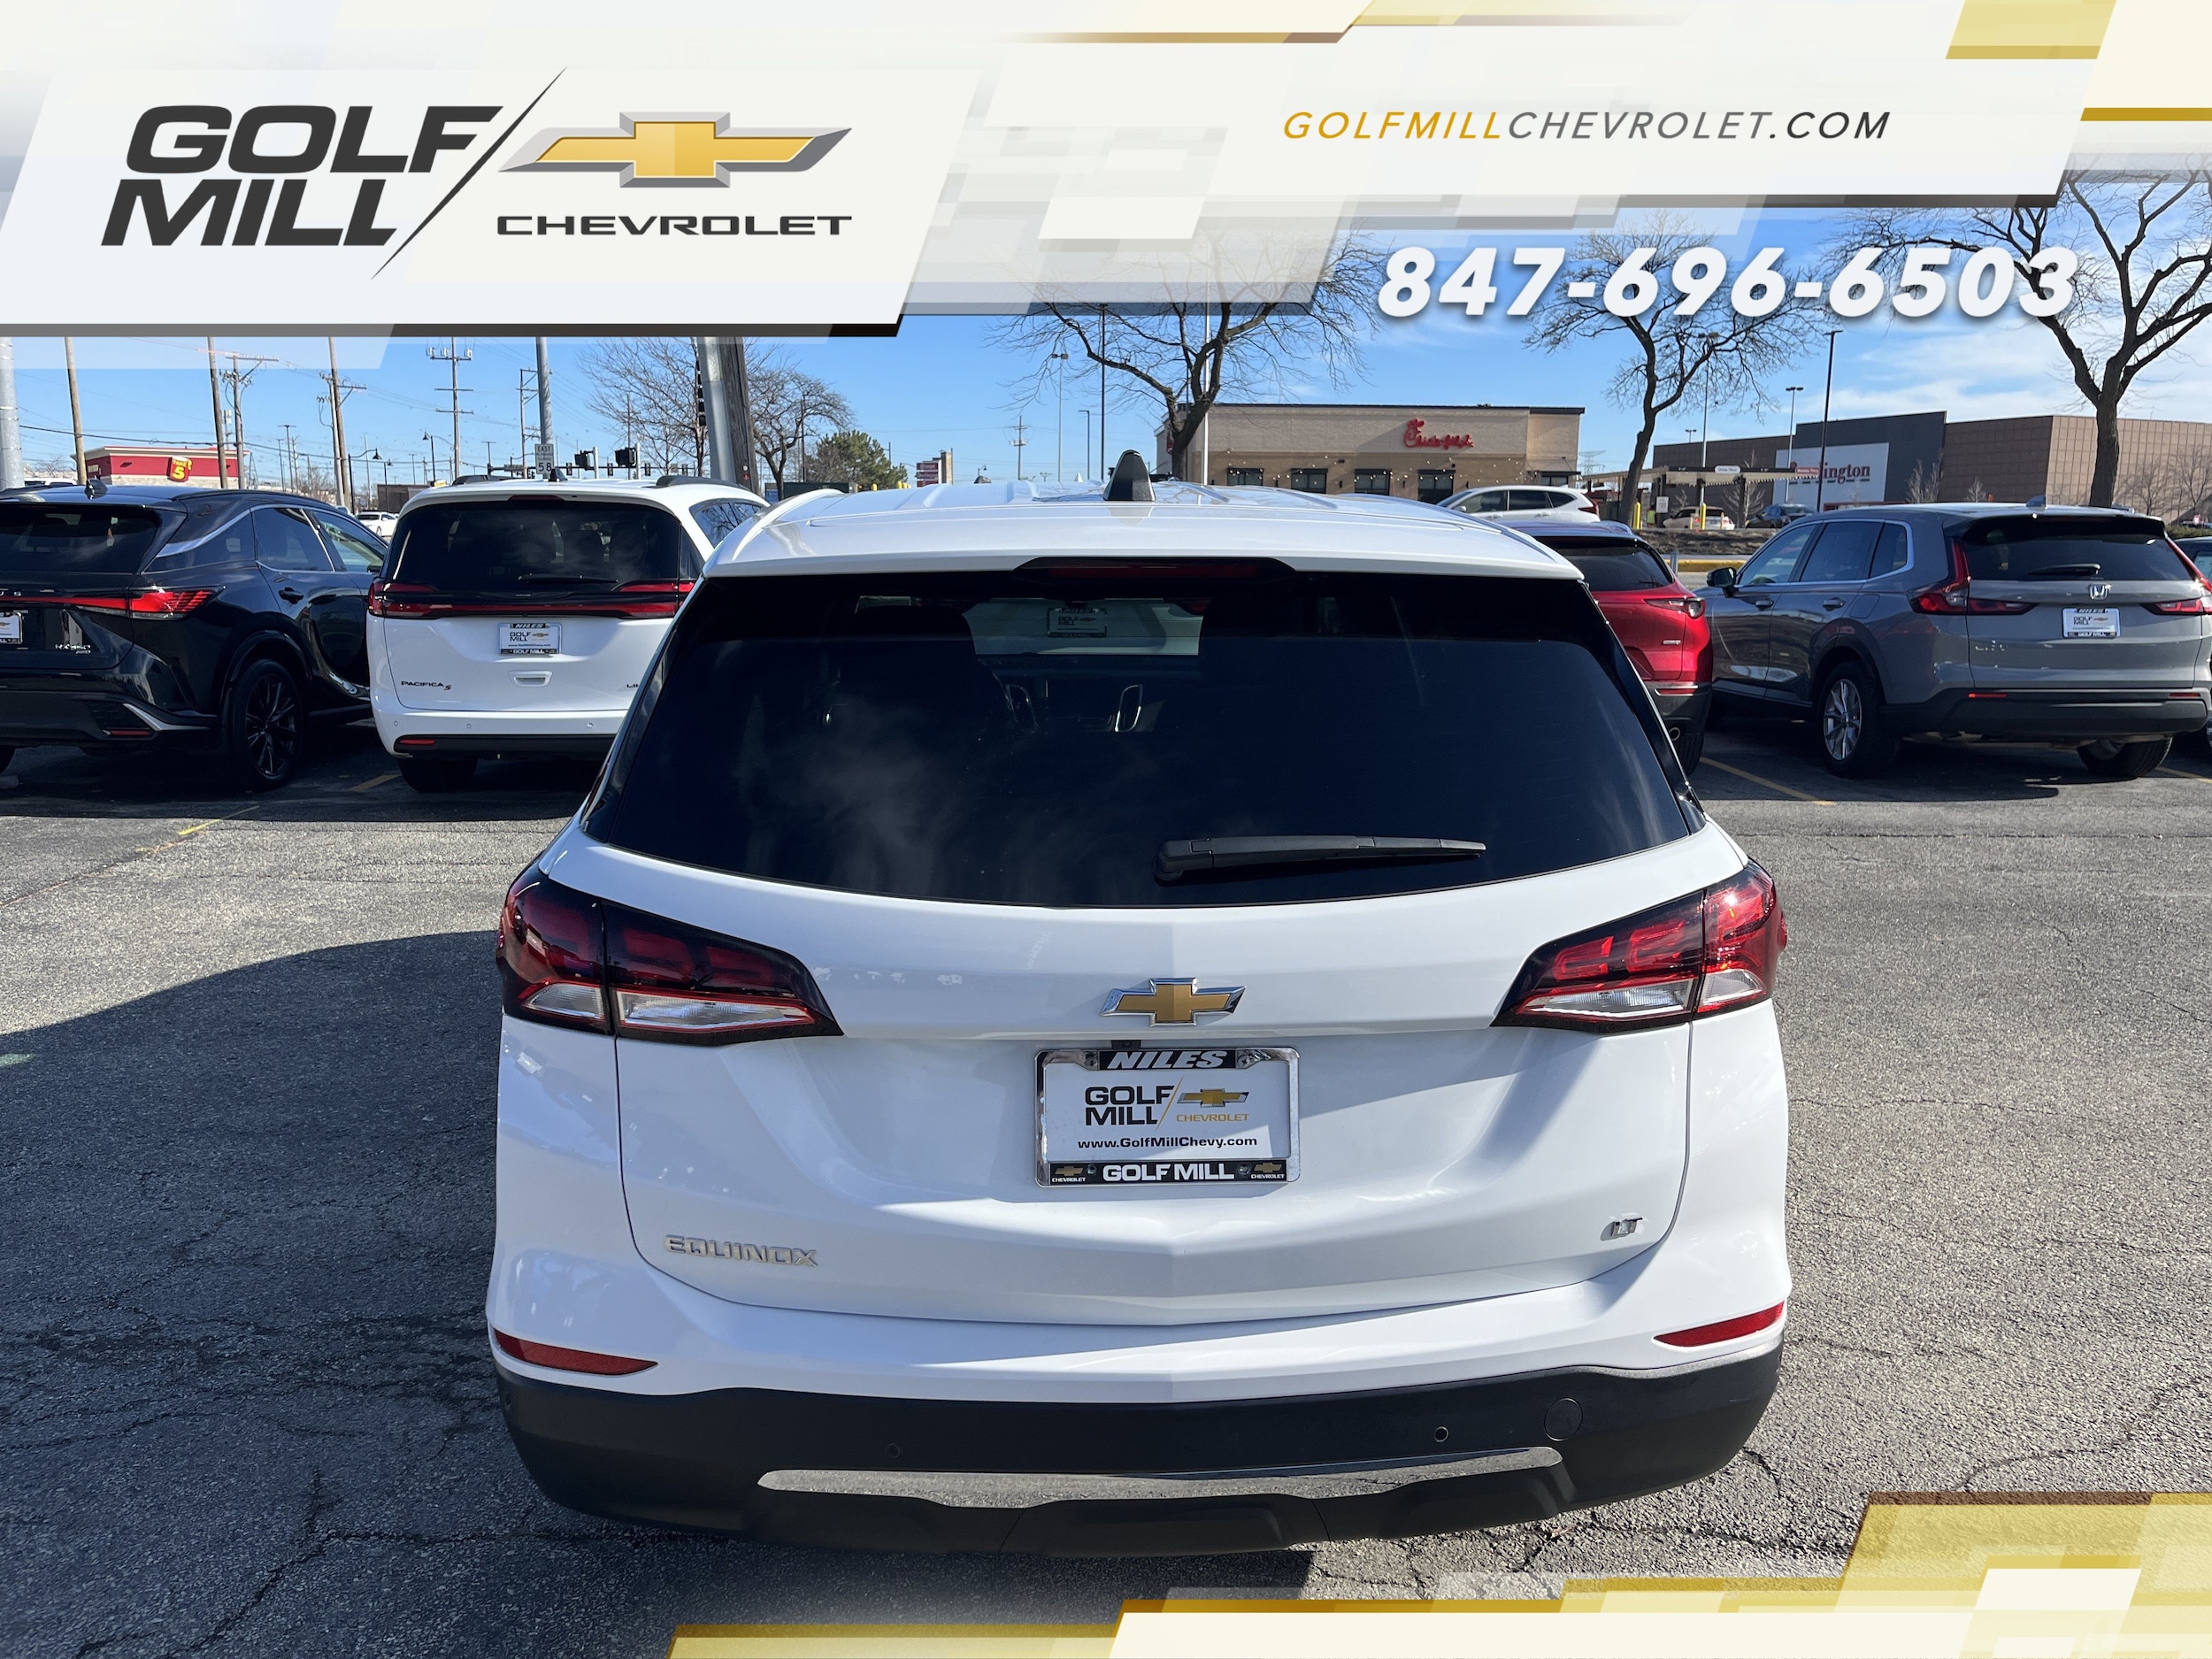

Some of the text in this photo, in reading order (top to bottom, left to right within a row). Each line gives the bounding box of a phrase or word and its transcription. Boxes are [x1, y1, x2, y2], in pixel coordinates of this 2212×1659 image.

[172, 465, 185, 480] 5
[538, 462, 552, 472] 58
[1107, 1051, 1228, 1070] NILES
[1085, 1086, 1175, 1105] GOLF
[1085, 1107, 1158, 1125] MILL
[1176, 1114, 1249, 1123] CHEVROLET
[1077, 1137, 1258, 1149] www.GolfMillChevy.com
[1102, 1164, 1235, 1181] GOLF MILL
[1610, 1214, 1643, 1239] LT
[665, 1234, 818, 1267] EQUINOX
